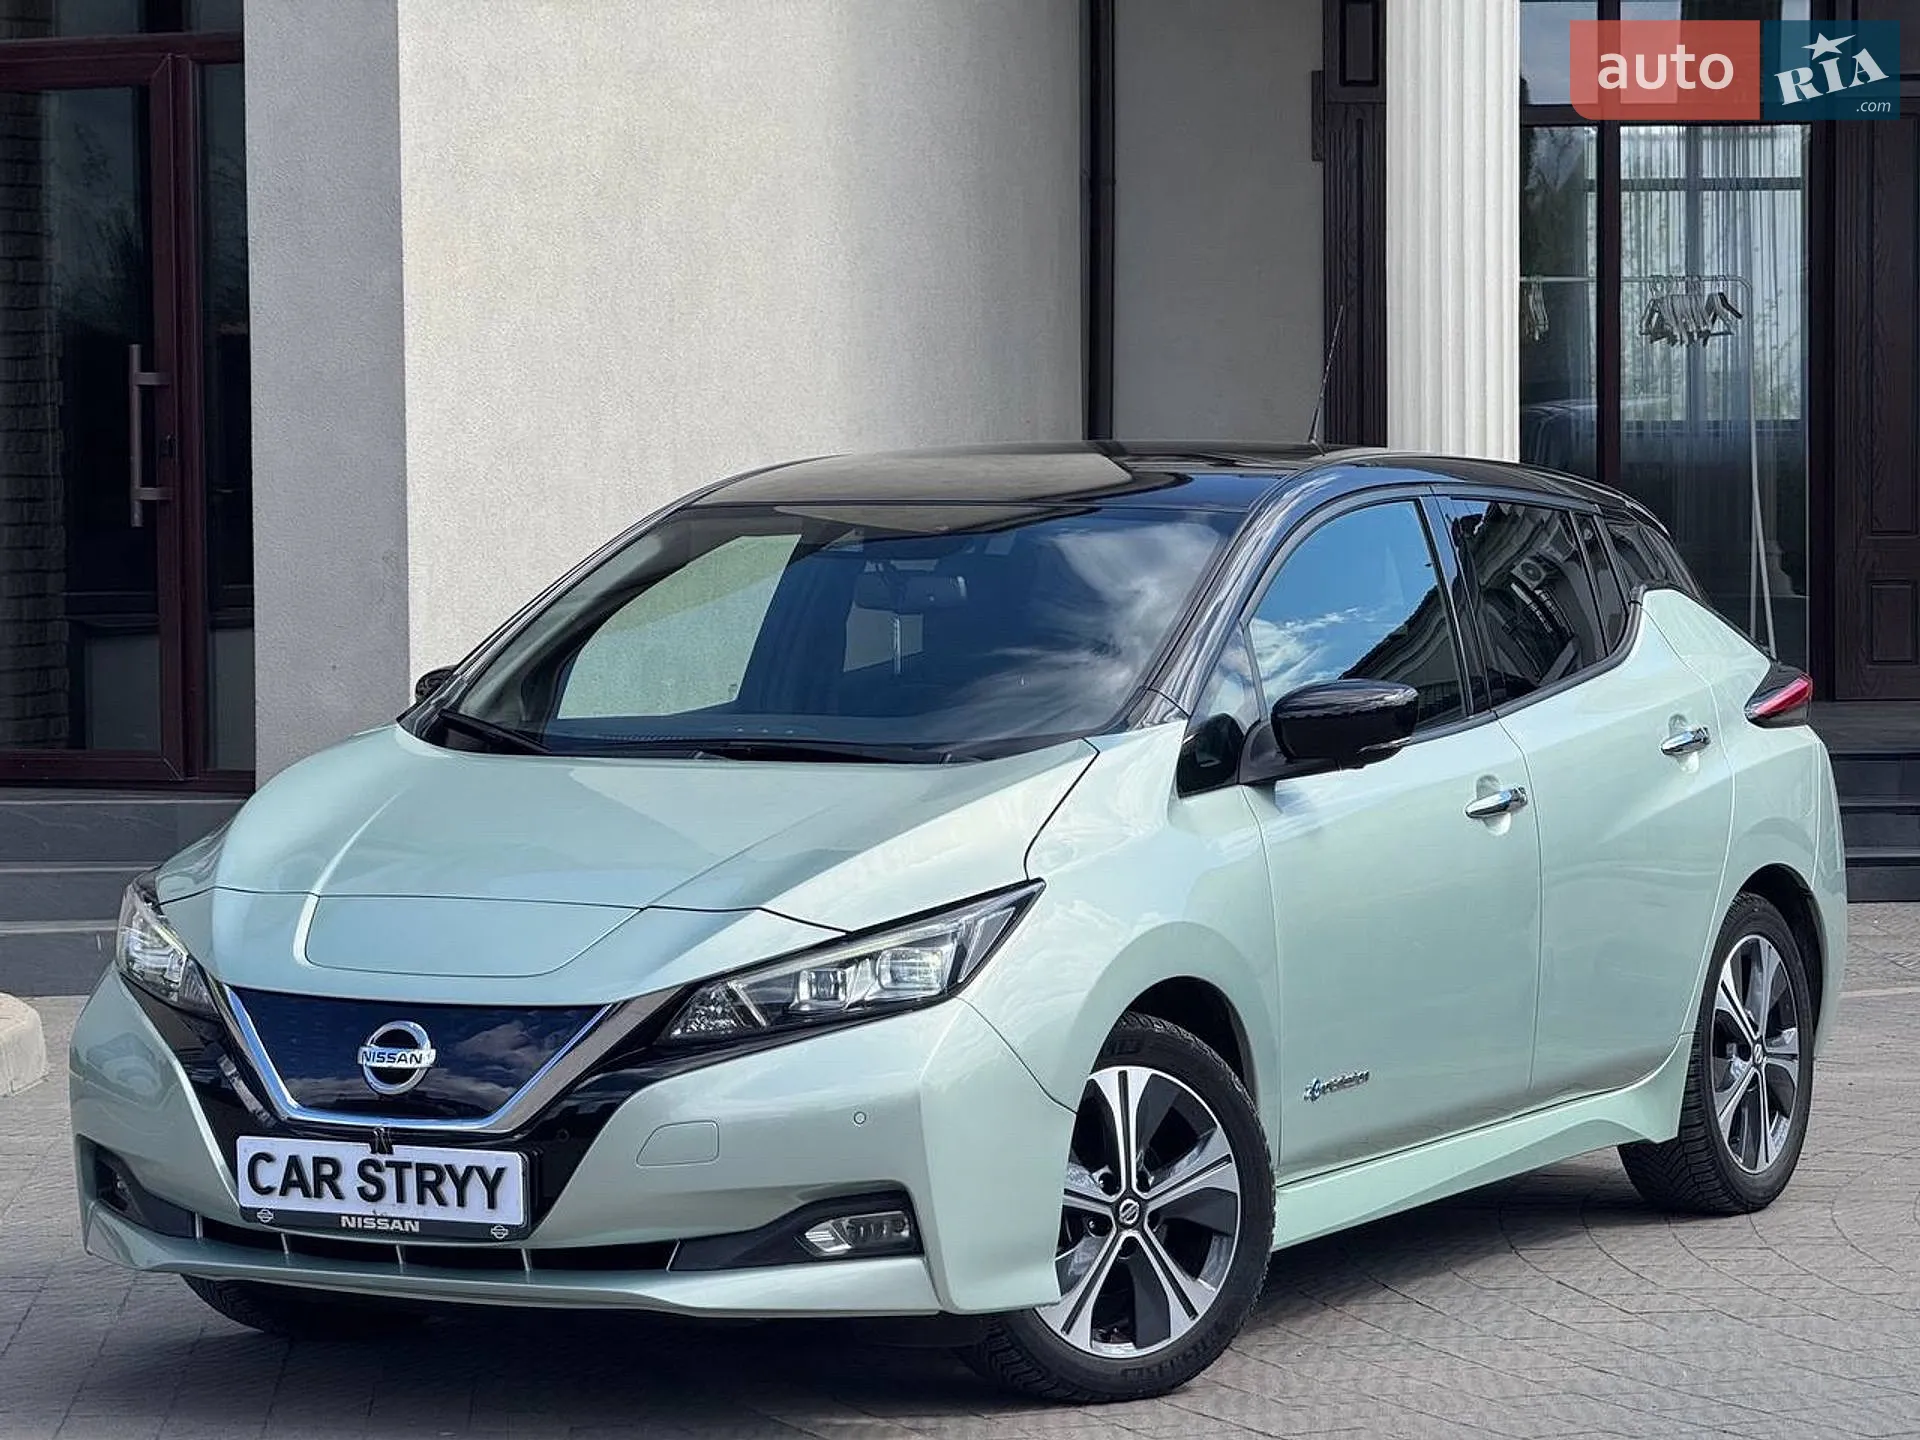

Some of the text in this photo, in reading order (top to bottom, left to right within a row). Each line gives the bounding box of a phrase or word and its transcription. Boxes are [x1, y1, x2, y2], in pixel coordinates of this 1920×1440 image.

[361, 1050, 423, 1065] NISSAN
[247, 1152, 506, 1210] CAR STRYY
[340, 1215, 420, 1233] NISSAN
